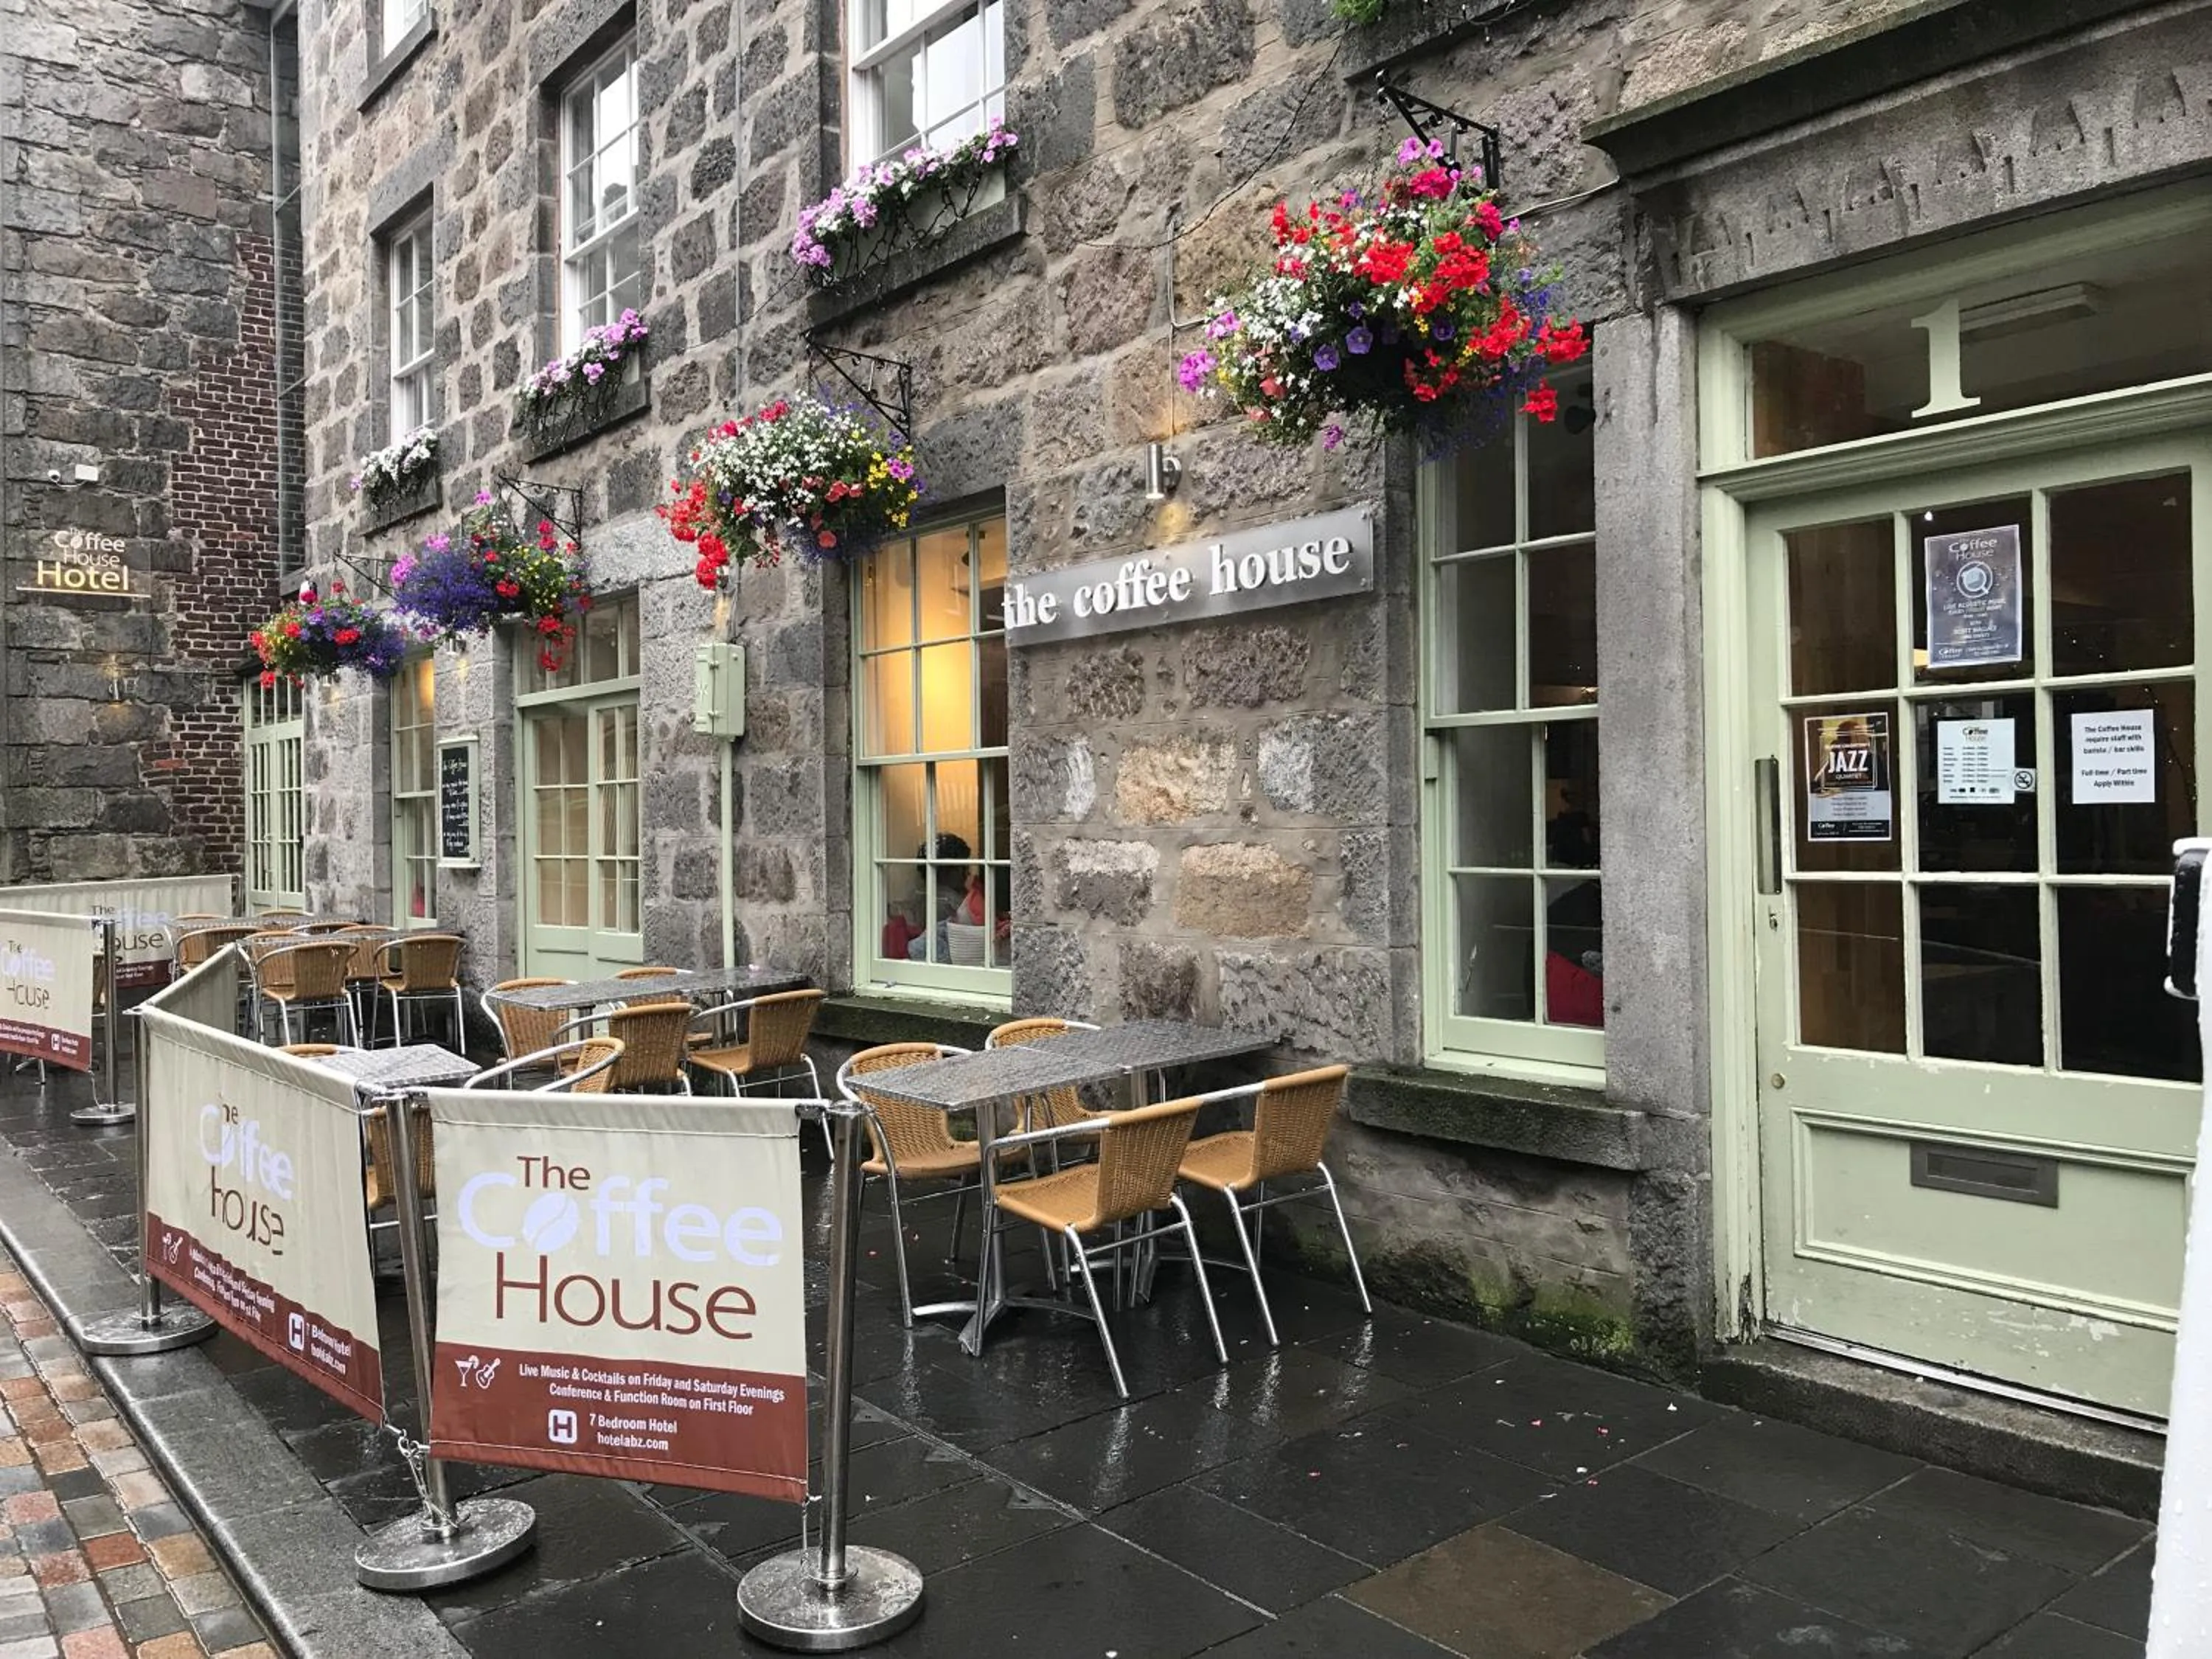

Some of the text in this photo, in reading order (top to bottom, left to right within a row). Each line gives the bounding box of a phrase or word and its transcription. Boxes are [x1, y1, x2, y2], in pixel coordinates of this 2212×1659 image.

[1911, 298, 1981, 418] 1
[54, 530, 125, 553] Coffee
[1950, 538, 1997, 553] Coffee
[63, 548, 120, 567] House
[1956, 549, 1994, 561] House
[38, 560, 129, 591] Hotel
[1001, 534, 1352, 630] the coffee house
[1829, 750, 1868, 773] JAZZ
[91, 905, 115, 915] The
[114, 932, 164, 951] ouse
[517, 1155, 591, 1191] The
[457, 1171, 783, 1267] Coffee
[495, 1251, 757, 1340] House
[519, 1363, 785, 1403] Live Music & Cocktails on Friday and Saturday Evenings
[549, 1383, 754, 1416] Conference & Function Room on First Floor
[589, 1413, 678, 1434] 7 Bedroom Hotel
[597, 1432, 669, 1450] hotelabz.com
